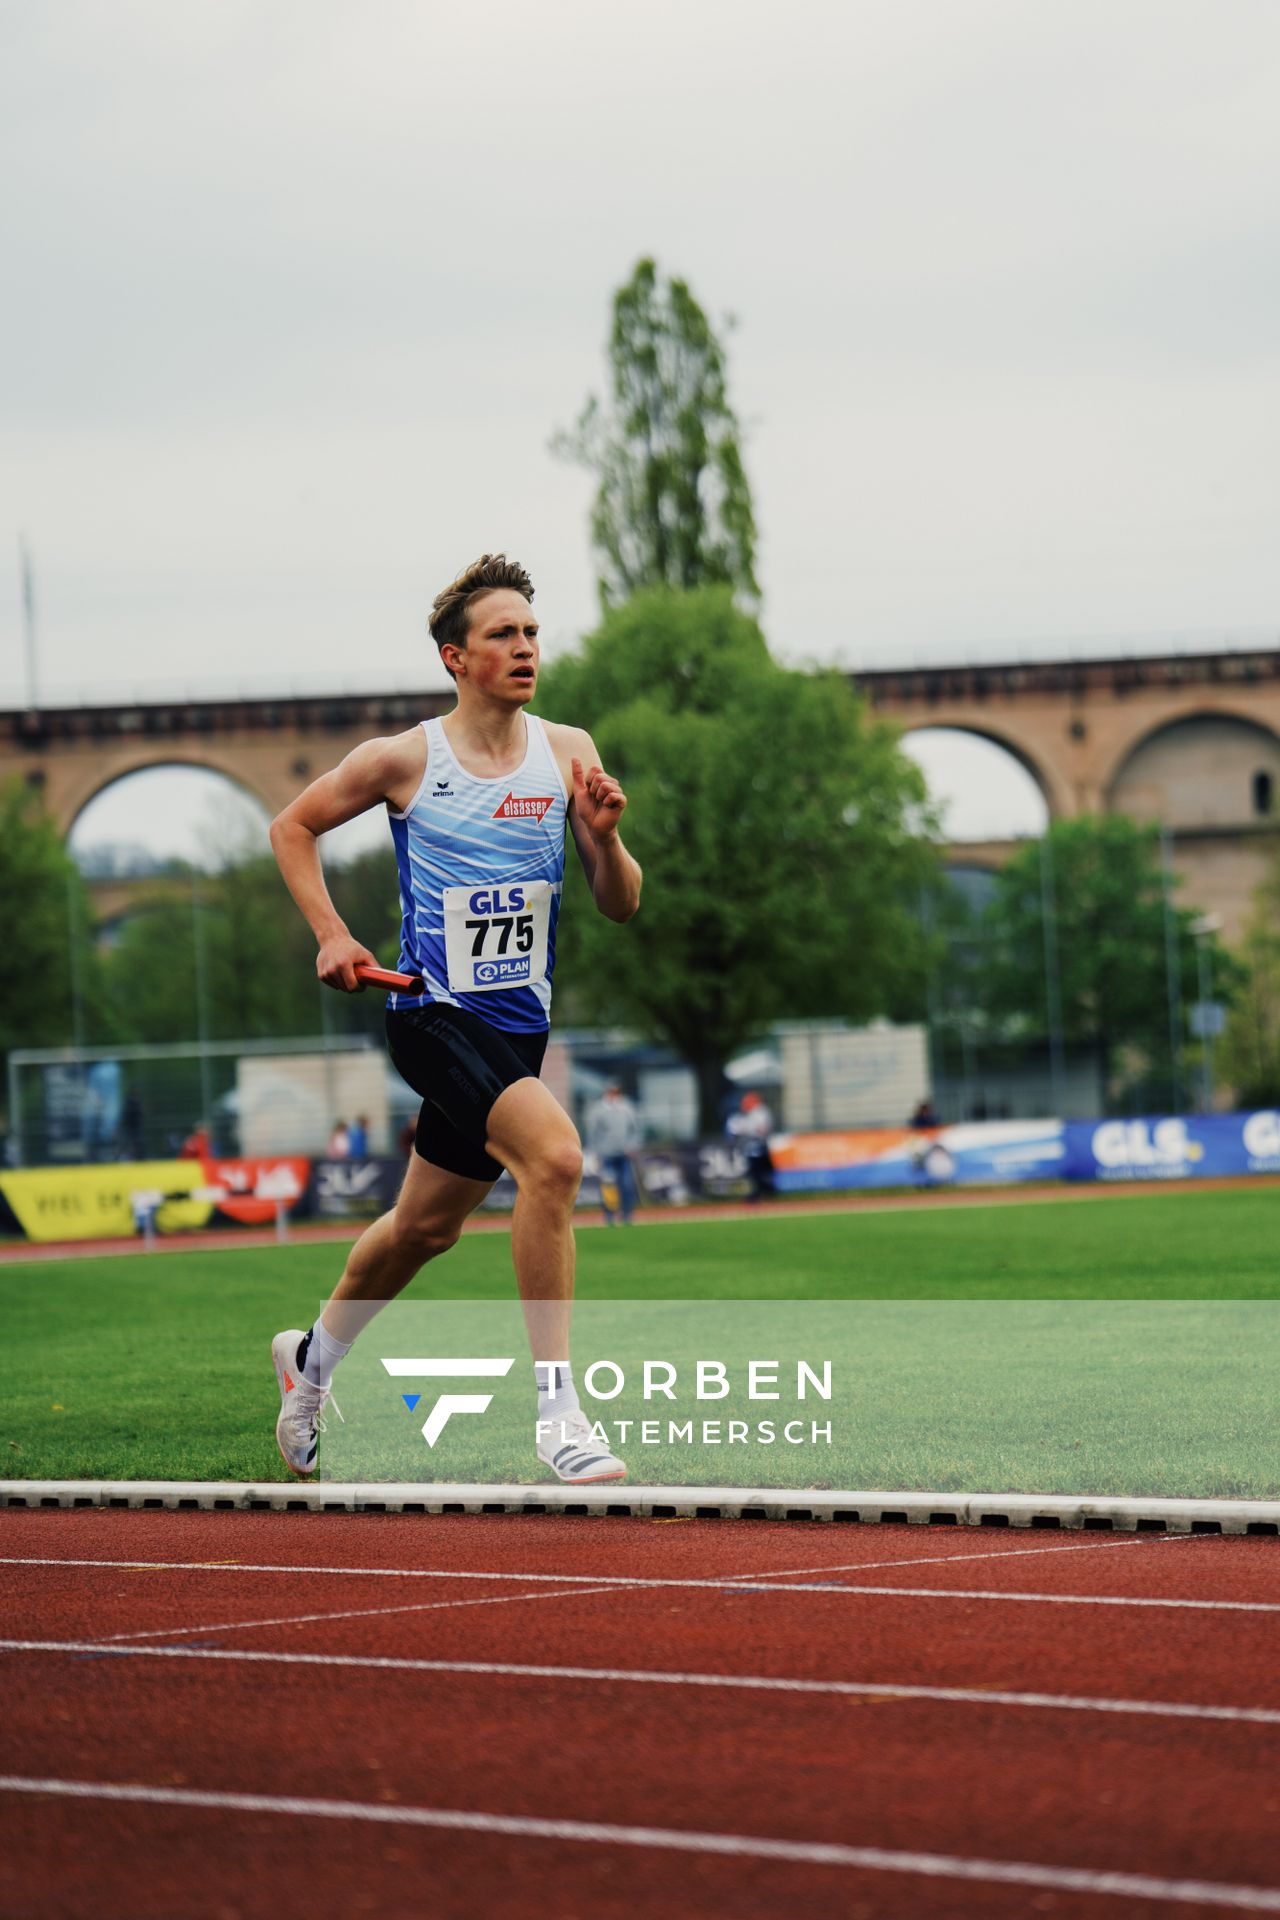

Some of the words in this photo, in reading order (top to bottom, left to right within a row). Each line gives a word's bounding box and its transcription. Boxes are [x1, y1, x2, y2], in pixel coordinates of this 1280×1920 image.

[503, 800, 547, 816] elsässer
[465, 914, 534, 957] 775
[500, 960, 529, 974] PLAN
